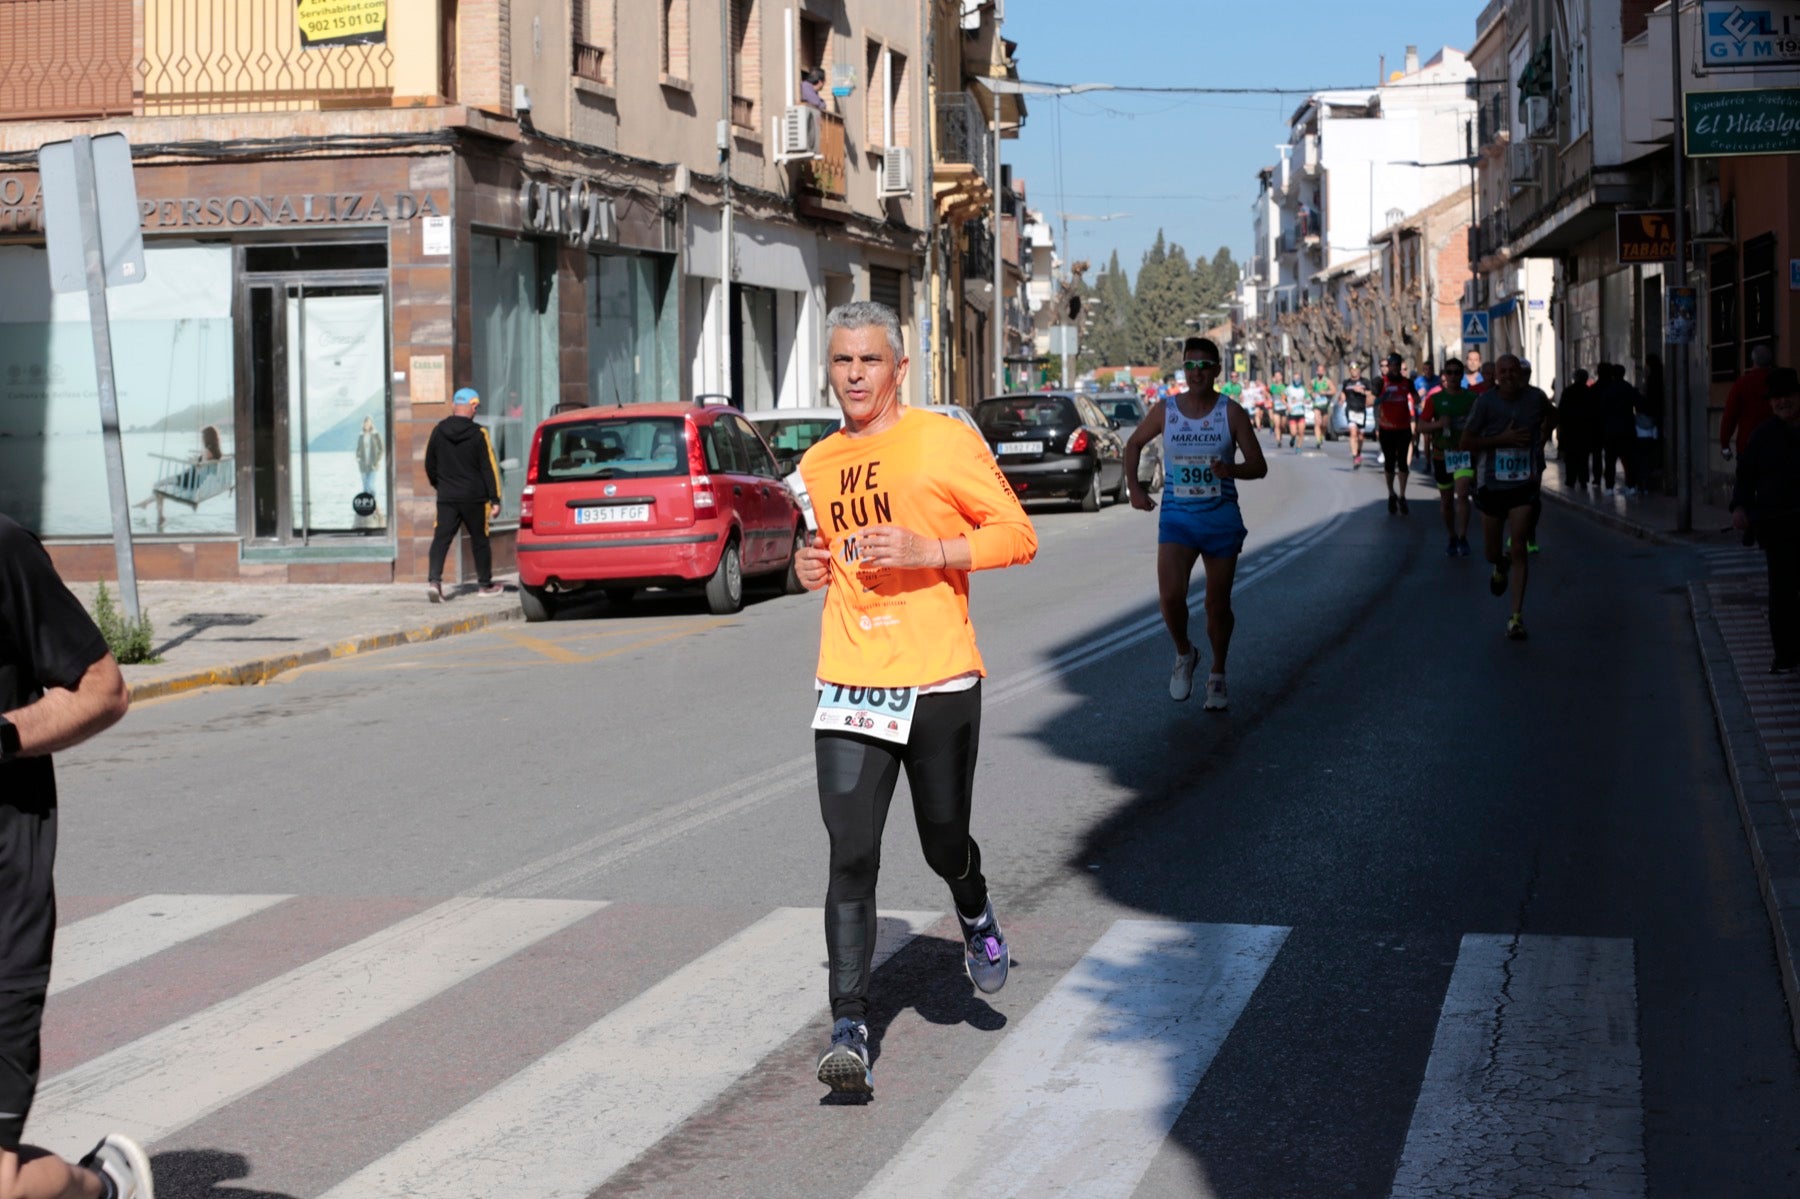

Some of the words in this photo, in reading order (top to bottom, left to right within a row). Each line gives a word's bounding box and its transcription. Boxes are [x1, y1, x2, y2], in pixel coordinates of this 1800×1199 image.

[300, 1, 385, 19] Servihabitat.com
[308, 20, 329, 32] 902
[333, 17, 346, 28] 15
[348, 15, 362, 26] 01
[365, 12, 379, 24] 02
[1722, 5, 1800, 43] ELI
[1710, 41, 1772, 57] GYM
[1695, 114, 1721, 134] El
[138, 190, 441, 228] PERSONALIZADA
[1171, 433, 1222, 442] MARACENA
[1500, 457, 1527, 471] 1071
[840, 461, 880, 495] WE
[1181, 468, 1213, 484] 396
[584, 509, 615, 521] 9351
[620, 507, 645, 518] FGF
[831, 492, 892, 533] RUN
[831, 684, 911, 711] 1069
